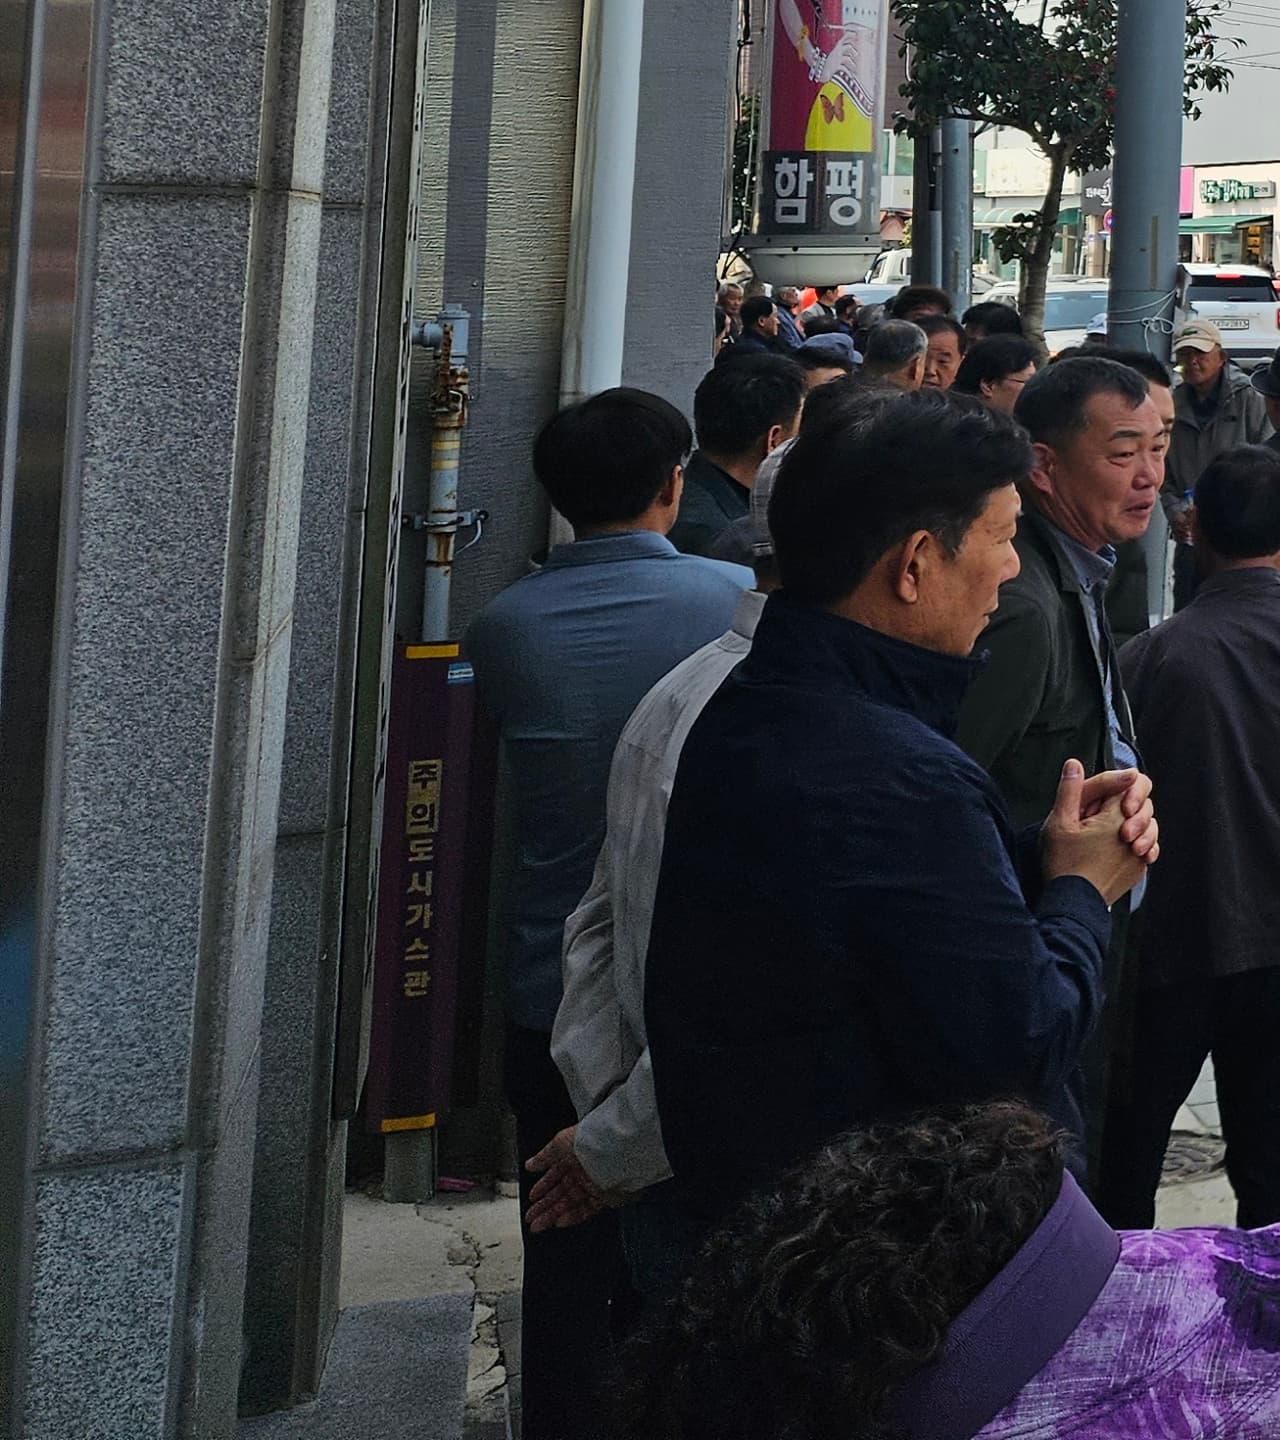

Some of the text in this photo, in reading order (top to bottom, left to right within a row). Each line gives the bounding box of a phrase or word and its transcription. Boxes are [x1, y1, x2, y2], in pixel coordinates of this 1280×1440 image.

[774, 157, 864, 229] 함평
[403, 762, 440, 998] 주의 도시가스관
